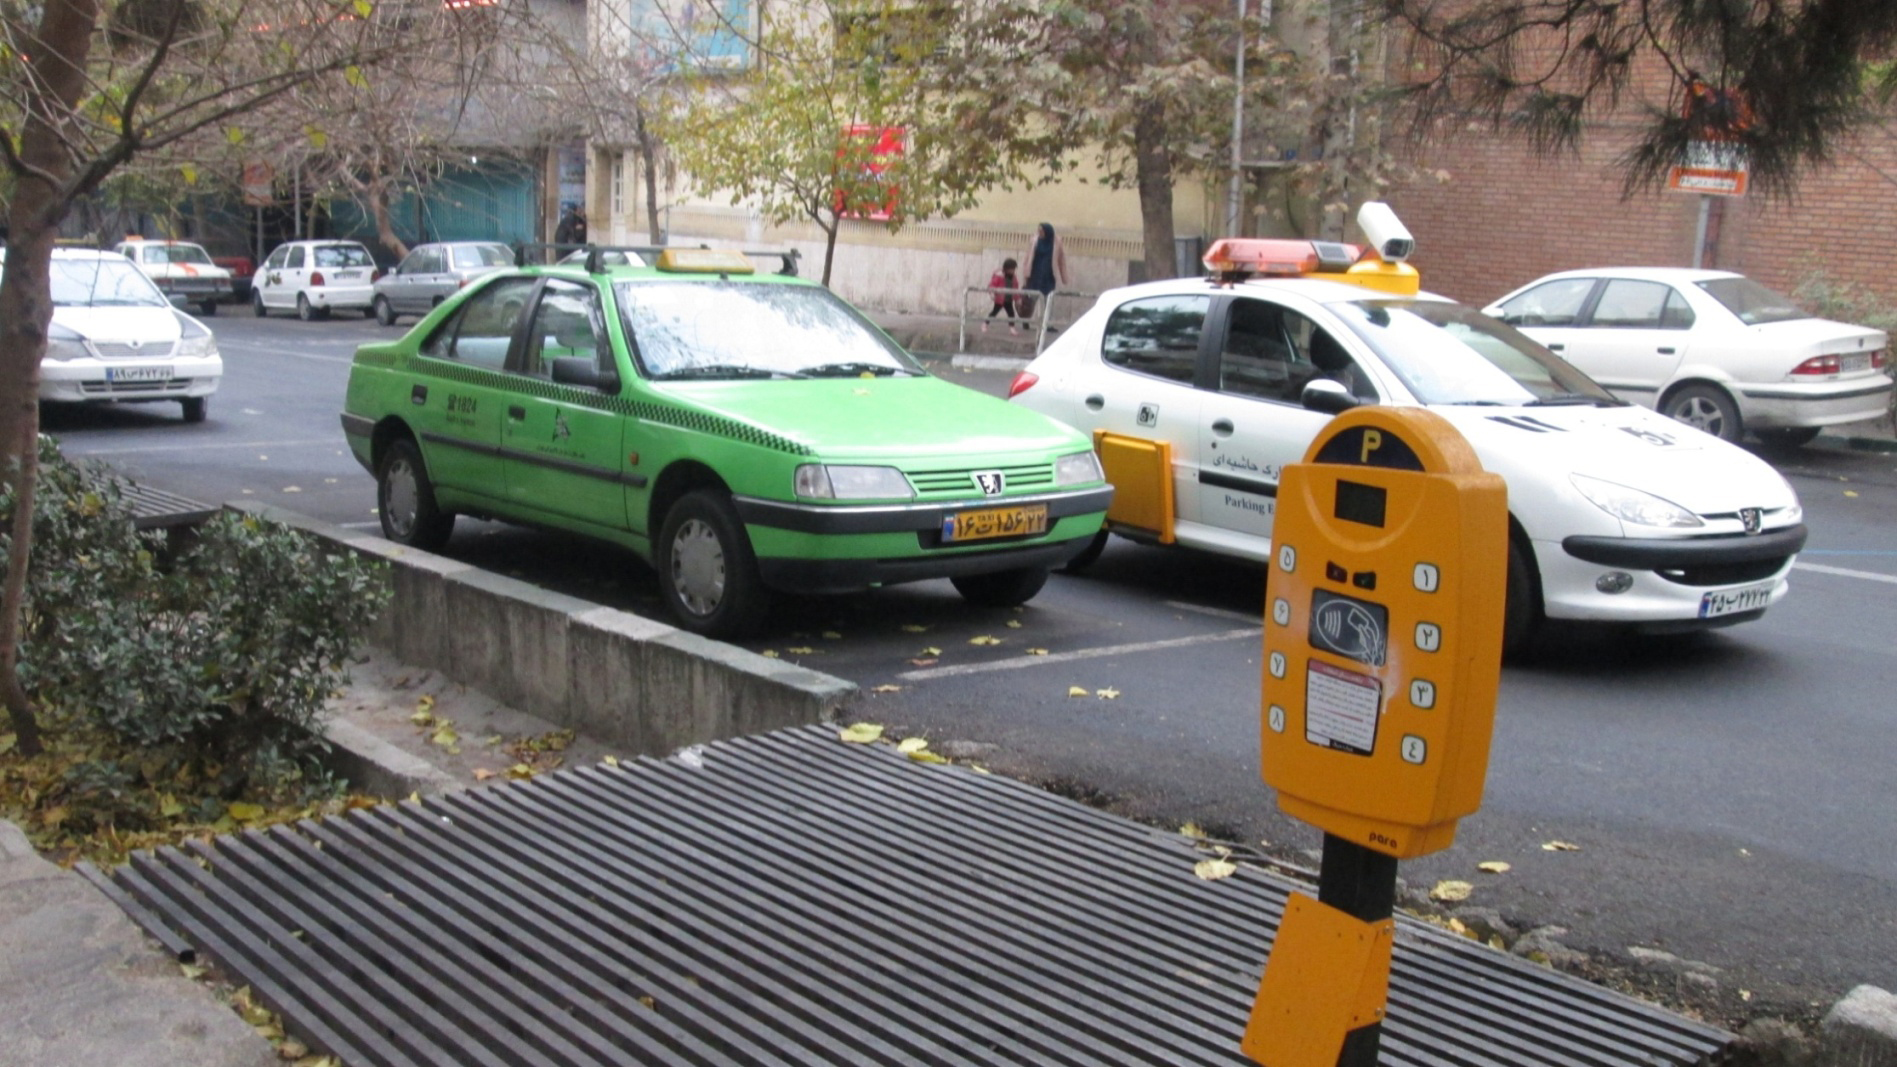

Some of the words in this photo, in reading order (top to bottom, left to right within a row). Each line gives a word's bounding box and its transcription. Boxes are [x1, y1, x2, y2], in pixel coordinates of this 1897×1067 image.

[457, 396, 477, 413] 1824
[1361, 429, 1382, 463] P
[1262, 464, 1283, 480] ارک
[1225, 494, 1266, 516] Parking
[1369, 832, 1397, 848] para
